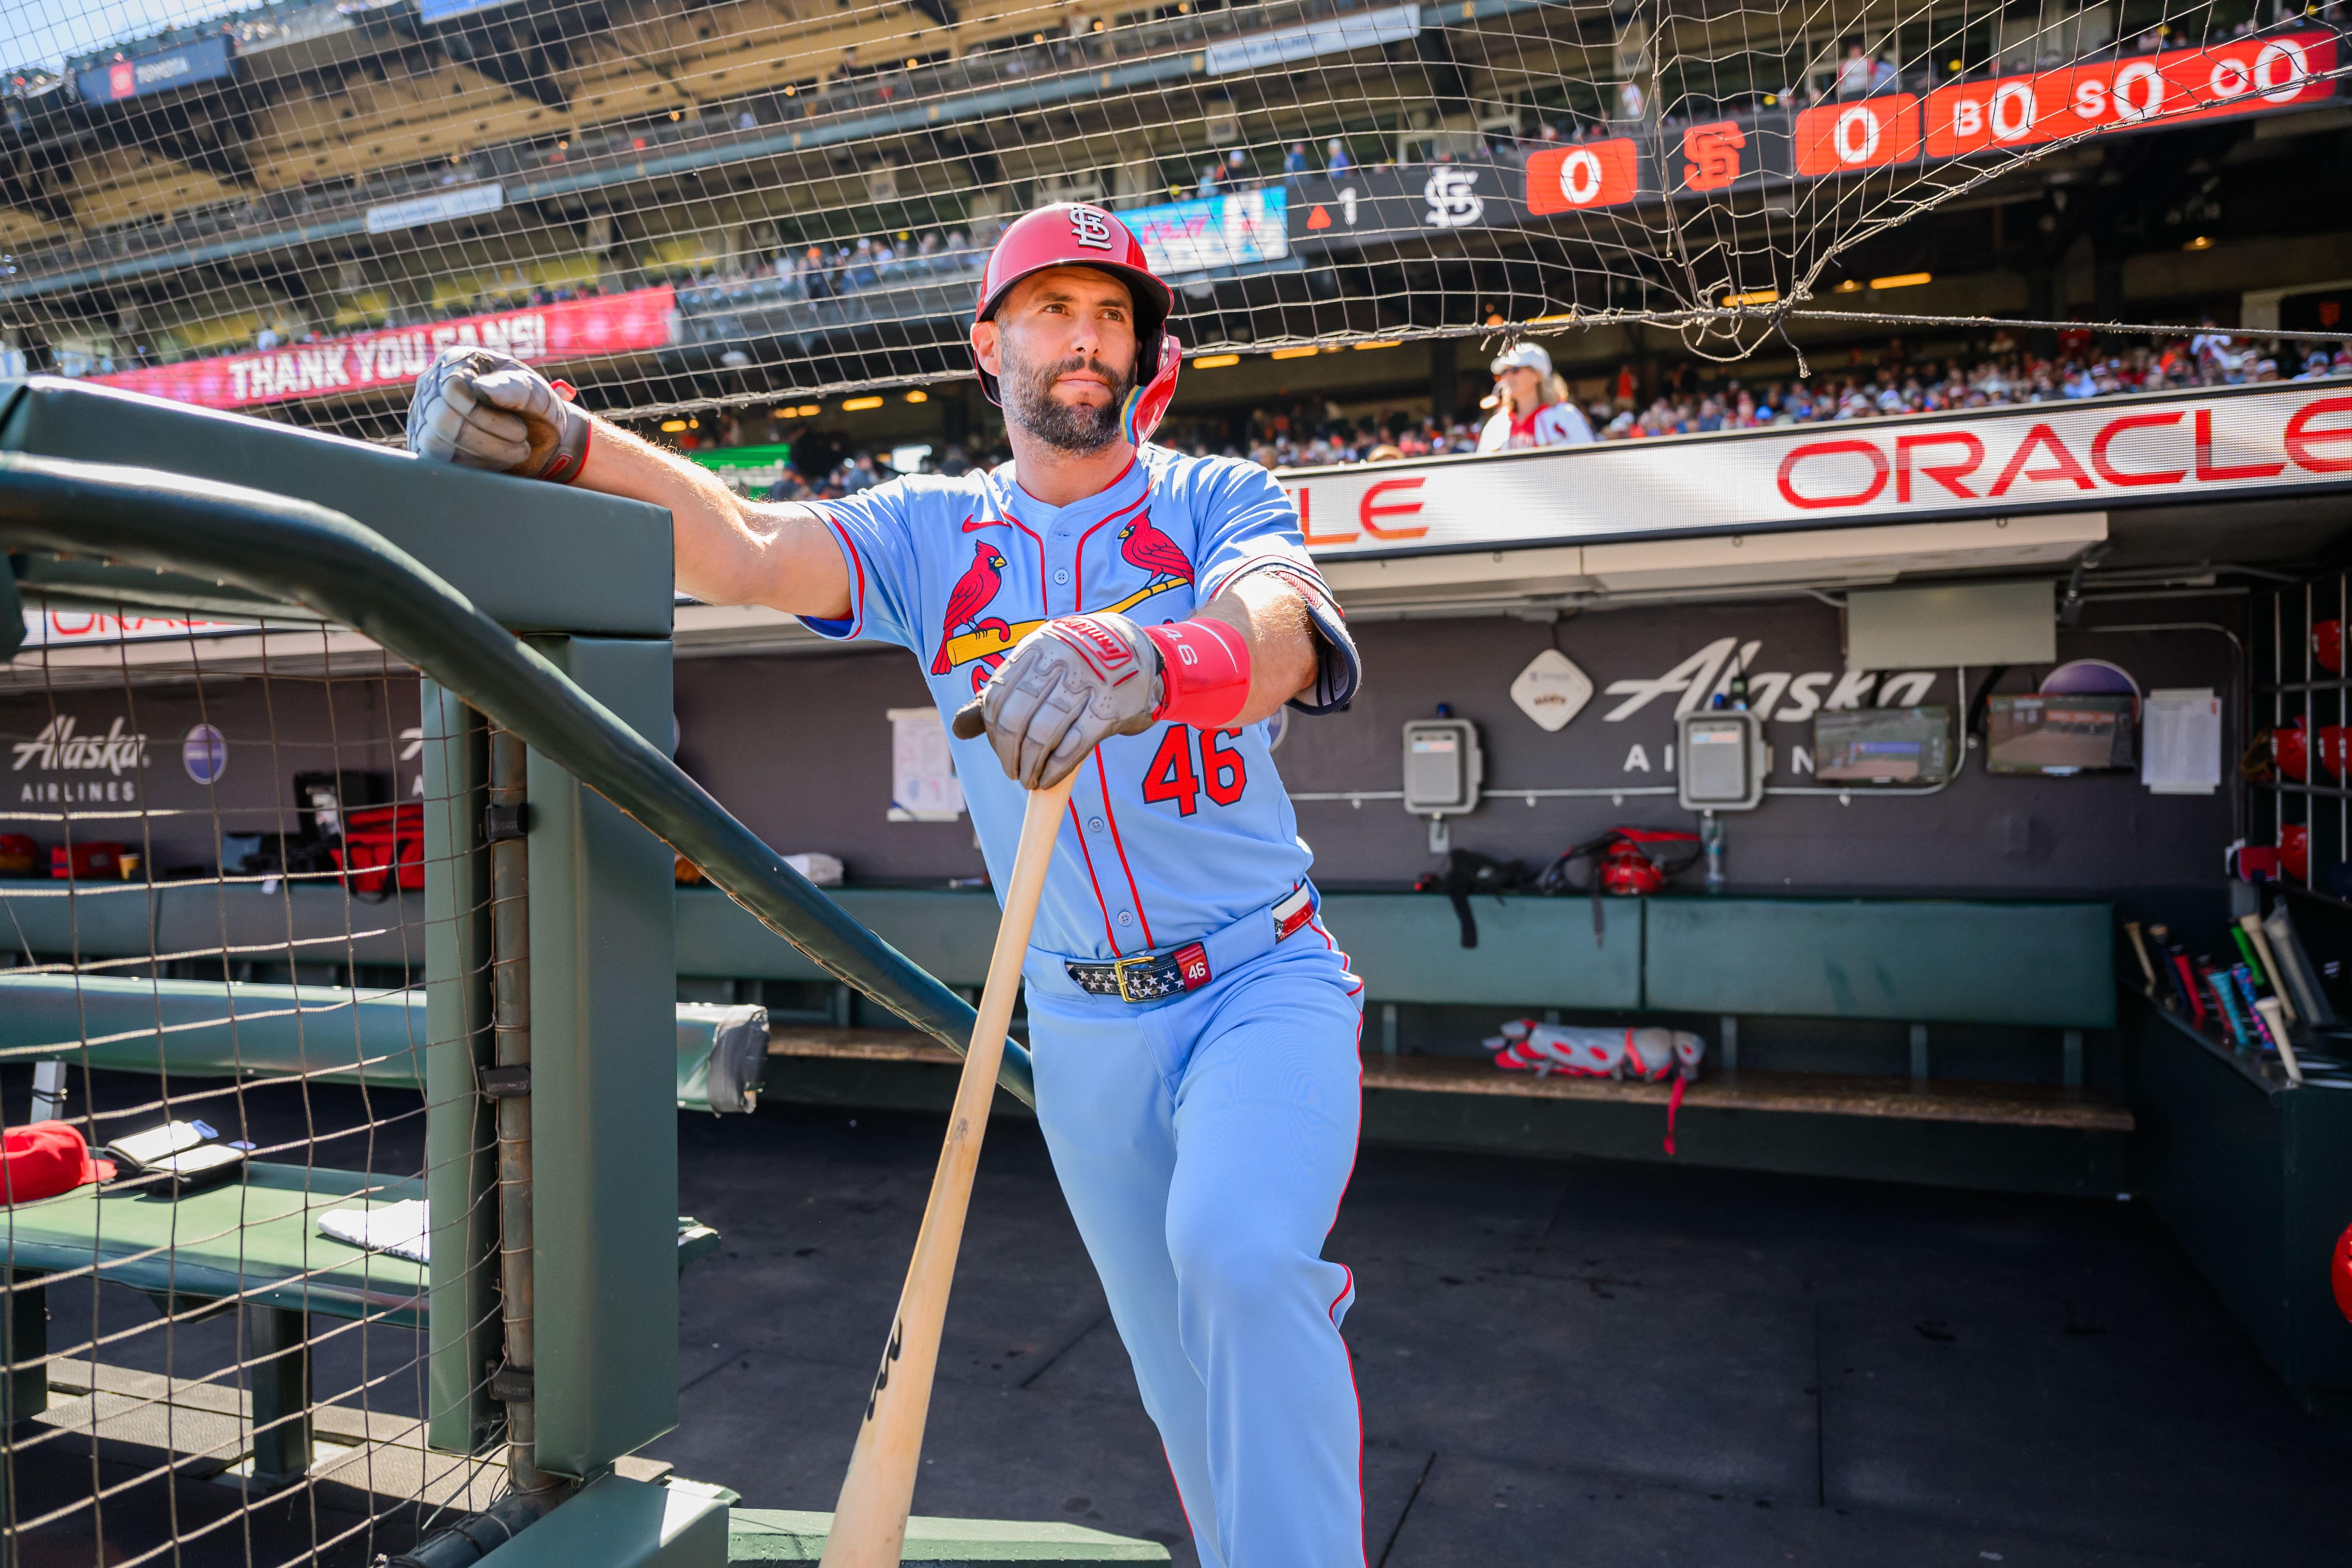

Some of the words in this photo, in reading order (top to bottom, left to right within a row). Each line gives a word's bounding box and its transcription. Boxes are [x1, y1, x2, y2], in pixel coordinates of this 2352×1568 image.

[1337, 187, 1358, 225] 1
[229, 344, 350, 401] THANK
[352, 330, 426, 382] YOU
[431, 312, 548, 360] FANS!
[1777, 396, 2352, 509] ORACLE
[1286, 477, 1429, 546] LE
[21, 781, 135, 803] AIRLINES
[1141, 724, 1248, 818] 46
[1189, 962, 1206, 979] 46
